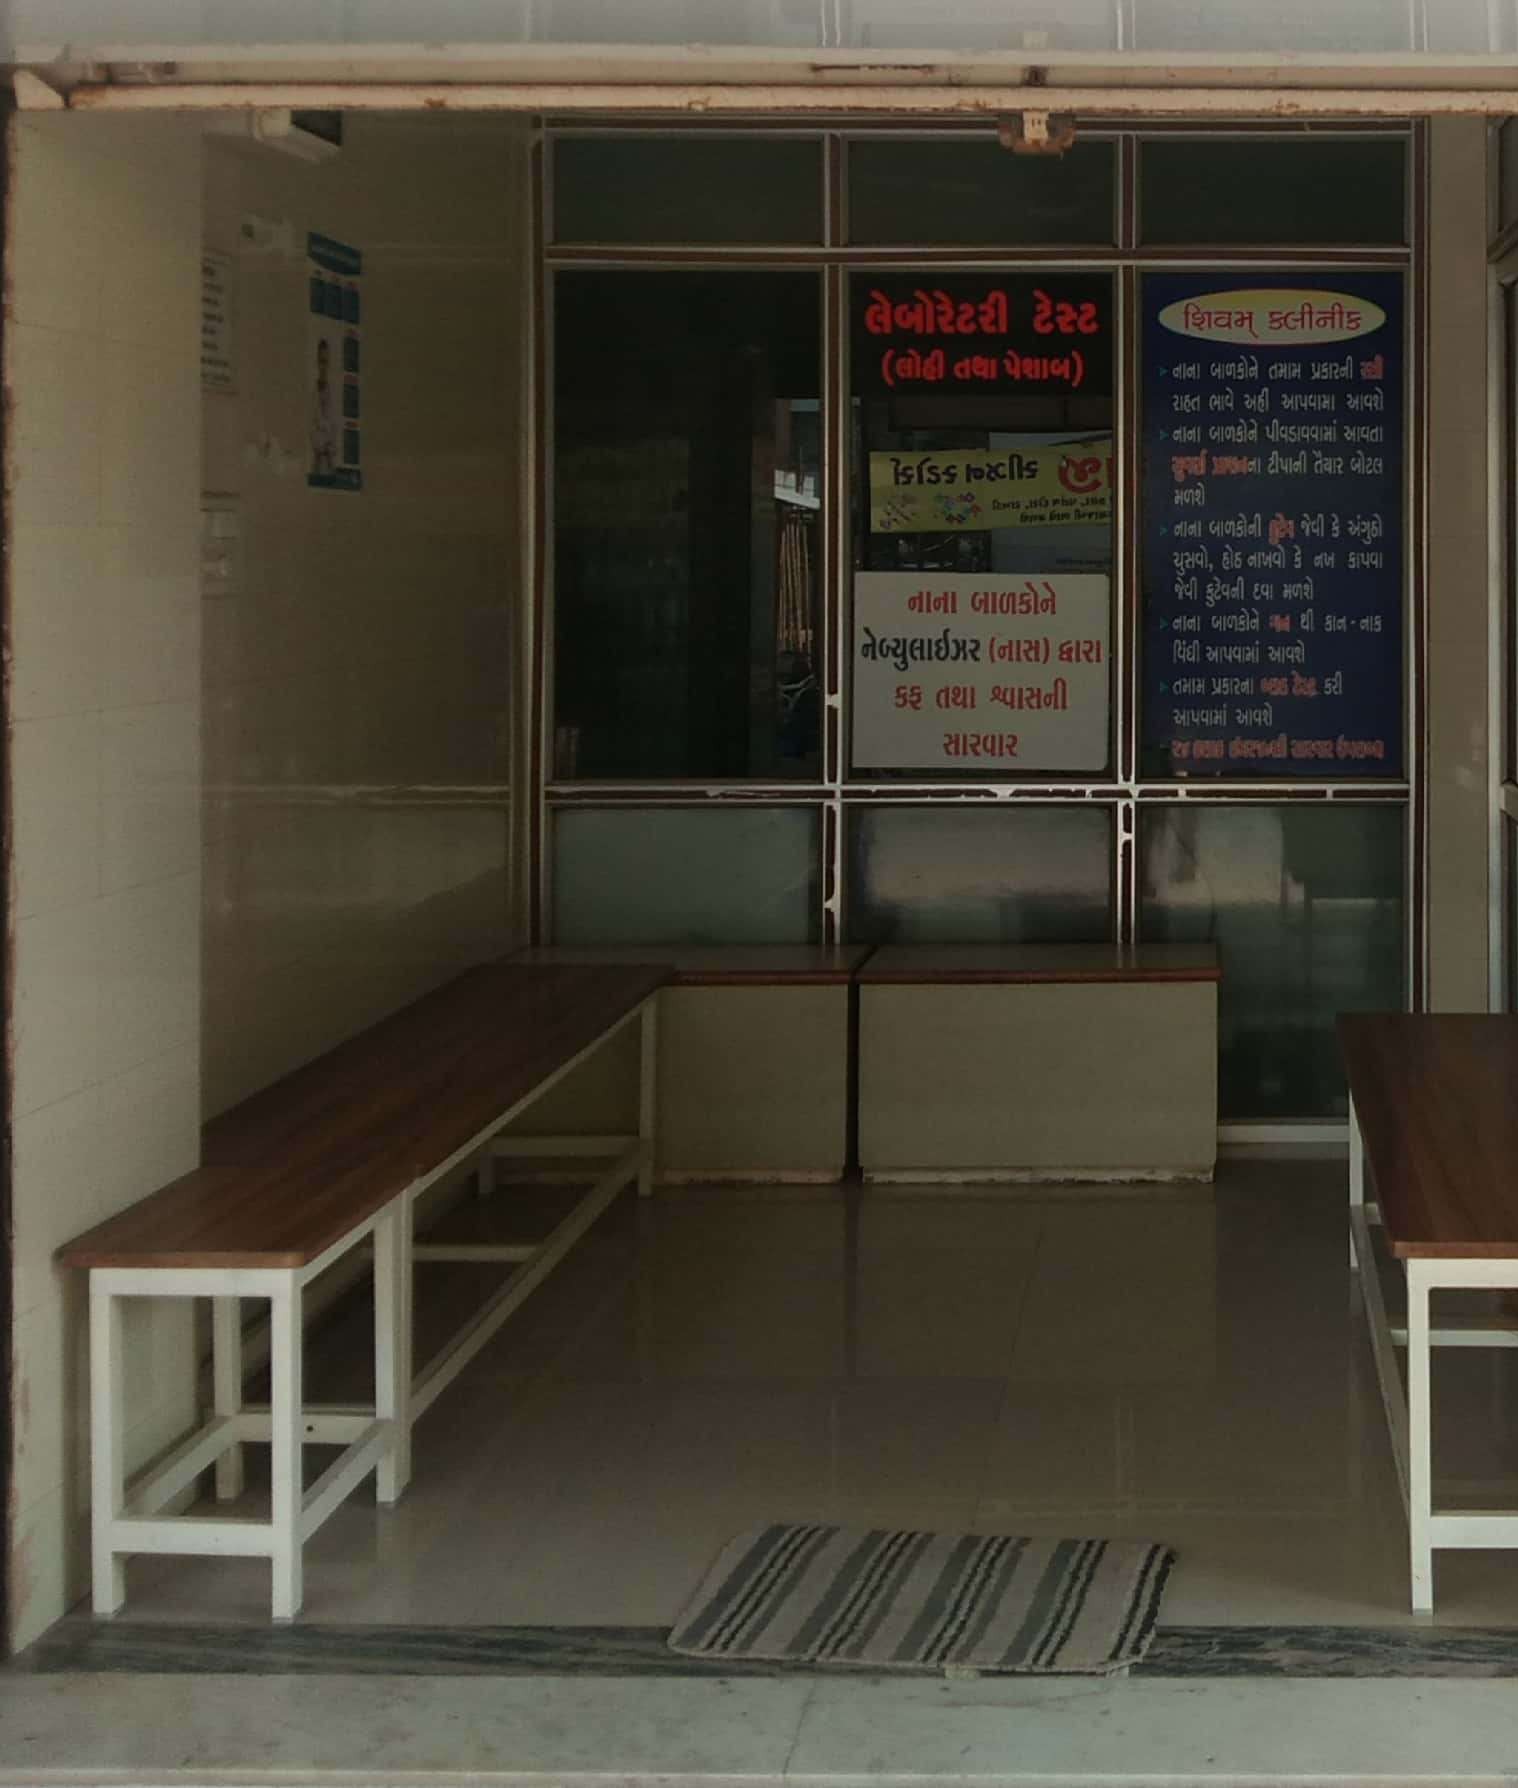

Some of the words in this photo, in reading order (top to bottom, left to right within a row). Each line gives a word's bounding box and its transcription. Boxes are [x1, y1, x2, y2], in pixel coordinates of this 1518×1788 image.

[865, 289, 1008, 334] લેબોરેટરી
[1033, 289, 1100, 334] ટેસ્ટ
[1184, 303, 1257, 338] શિવમ્
[1269, 303, 1361, 331] ક્લીનીક
[881, 348, 945, 387] (લોહી
[953, 355, 998, 380] તથા
[1003, 348, 1085, 388] પેશાબ)
[1172, 363, 1201, 380] નાના
[1210, 355, 1259, 380] બાળકોને
[1268, 363, 1301, 380] તમામ
[1311, 355, 1353, 380] પ્રકારની
[1172, 394, 1201, 412] રાહત
[1209, 387, 1234, 411] ભાવે
[1346, 387, 1384, 411] આવશે
[1172, 426, 1201, 442] નાના
[1209, 418, 1258, 443] બાળકોને
[1266, 418, 1337, 443] પીવડાવવામાં
[1344, 426, 1384, 443] આવતા
[1267, 450, 1307, 474] ટીપાની
[1313, 450, 1344, 474] તૈયાર
[1350, 450, 1383, 474] બોટલ
[1174, 482, 1205, 507] મળશે
[1174, 521, 1202, 537] નાના
[1209, 513, 1262, 537] બાળકોની
[1301, 513, 1324, 537] જેવી
[1331, 513, 1340, 537] કે
[1348, 513, 1383, 544] અંગુઠો
[1293, 544, 1302, 569] કે
[1314, 551, 1335, 569] નખ
[1347, 551, 1384, 569] કાપવા
[908, 591, 958, 614] નાના
[970, 581, 1057, 615] બાળકોને
[1174, 576, 1198, 601] જેવી
[1206, 576, 1245, 608] કુટેવની
[1253, 583, 1274, 601] દવા
[1282, 575, 1314, 601] મળશે
[1172, 615, 1201, 632] નાના
[1210, 607, 1260, 632] બાળકોને
[1300, 608, 1314, 632] થી
[861, 627, 981, 672] નેબ્યુલાઈઝર
[988, 638, 1050, 664] (નાસ)
[1058, 640, 1103, 663] દ્વારા
[1205, 639, 1260, 663] આપવામાં
[1267, 639, 1306, 664] આવશે
[895, 685, 923, 710] કફ
[935, 685, 976, 709] તથા
[990, 677, 1067, 710] શ્વાસની
[1172, 678, 1205, 695] તમામ
[1211, 678, 1254, 696] પ્રકારના
[1324, 671, 1343, 695] કરી
[1172, 703, 1227, 727] આપવામાં
[1235, 701, 1273, 727] આવશે
[943, 733, 1018, 757] સારવાર
